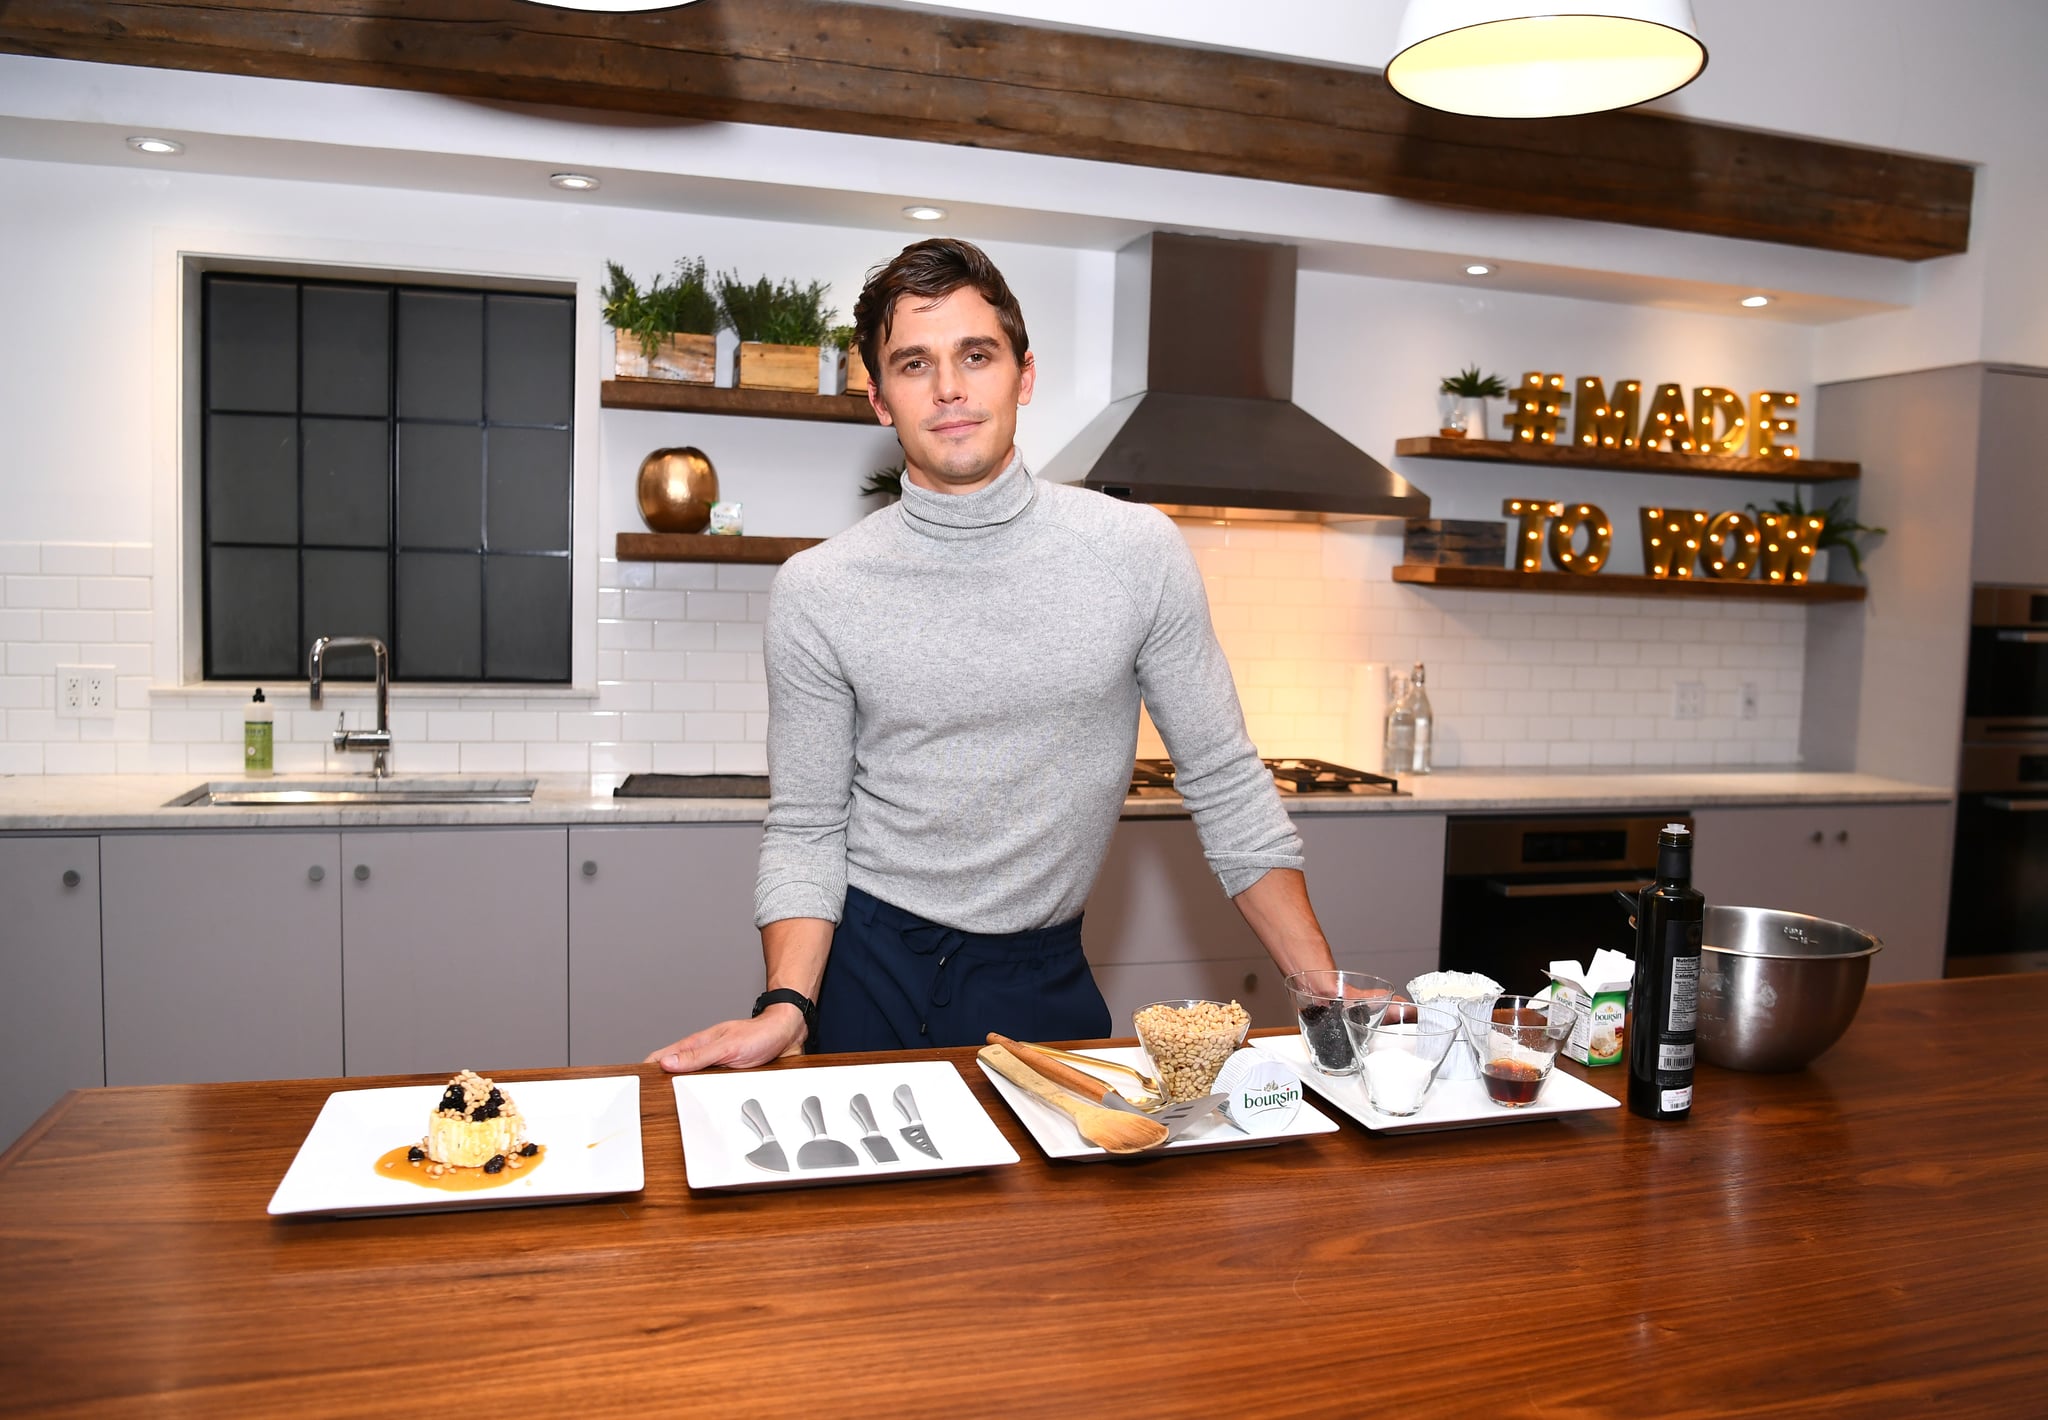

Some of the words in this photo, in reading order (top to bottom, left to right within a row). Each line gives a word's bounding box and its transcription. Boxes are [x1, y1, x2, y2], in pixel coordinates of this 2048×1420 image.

[1504, 372, 1799, 459] #MADE
[1503, 498, 1613, 575] TO
[1640, 506, 1824, 584] WOW
[1595, 1011, 1622, 1022] boursin
[1244, 1087, 1299, 1108] boursin
